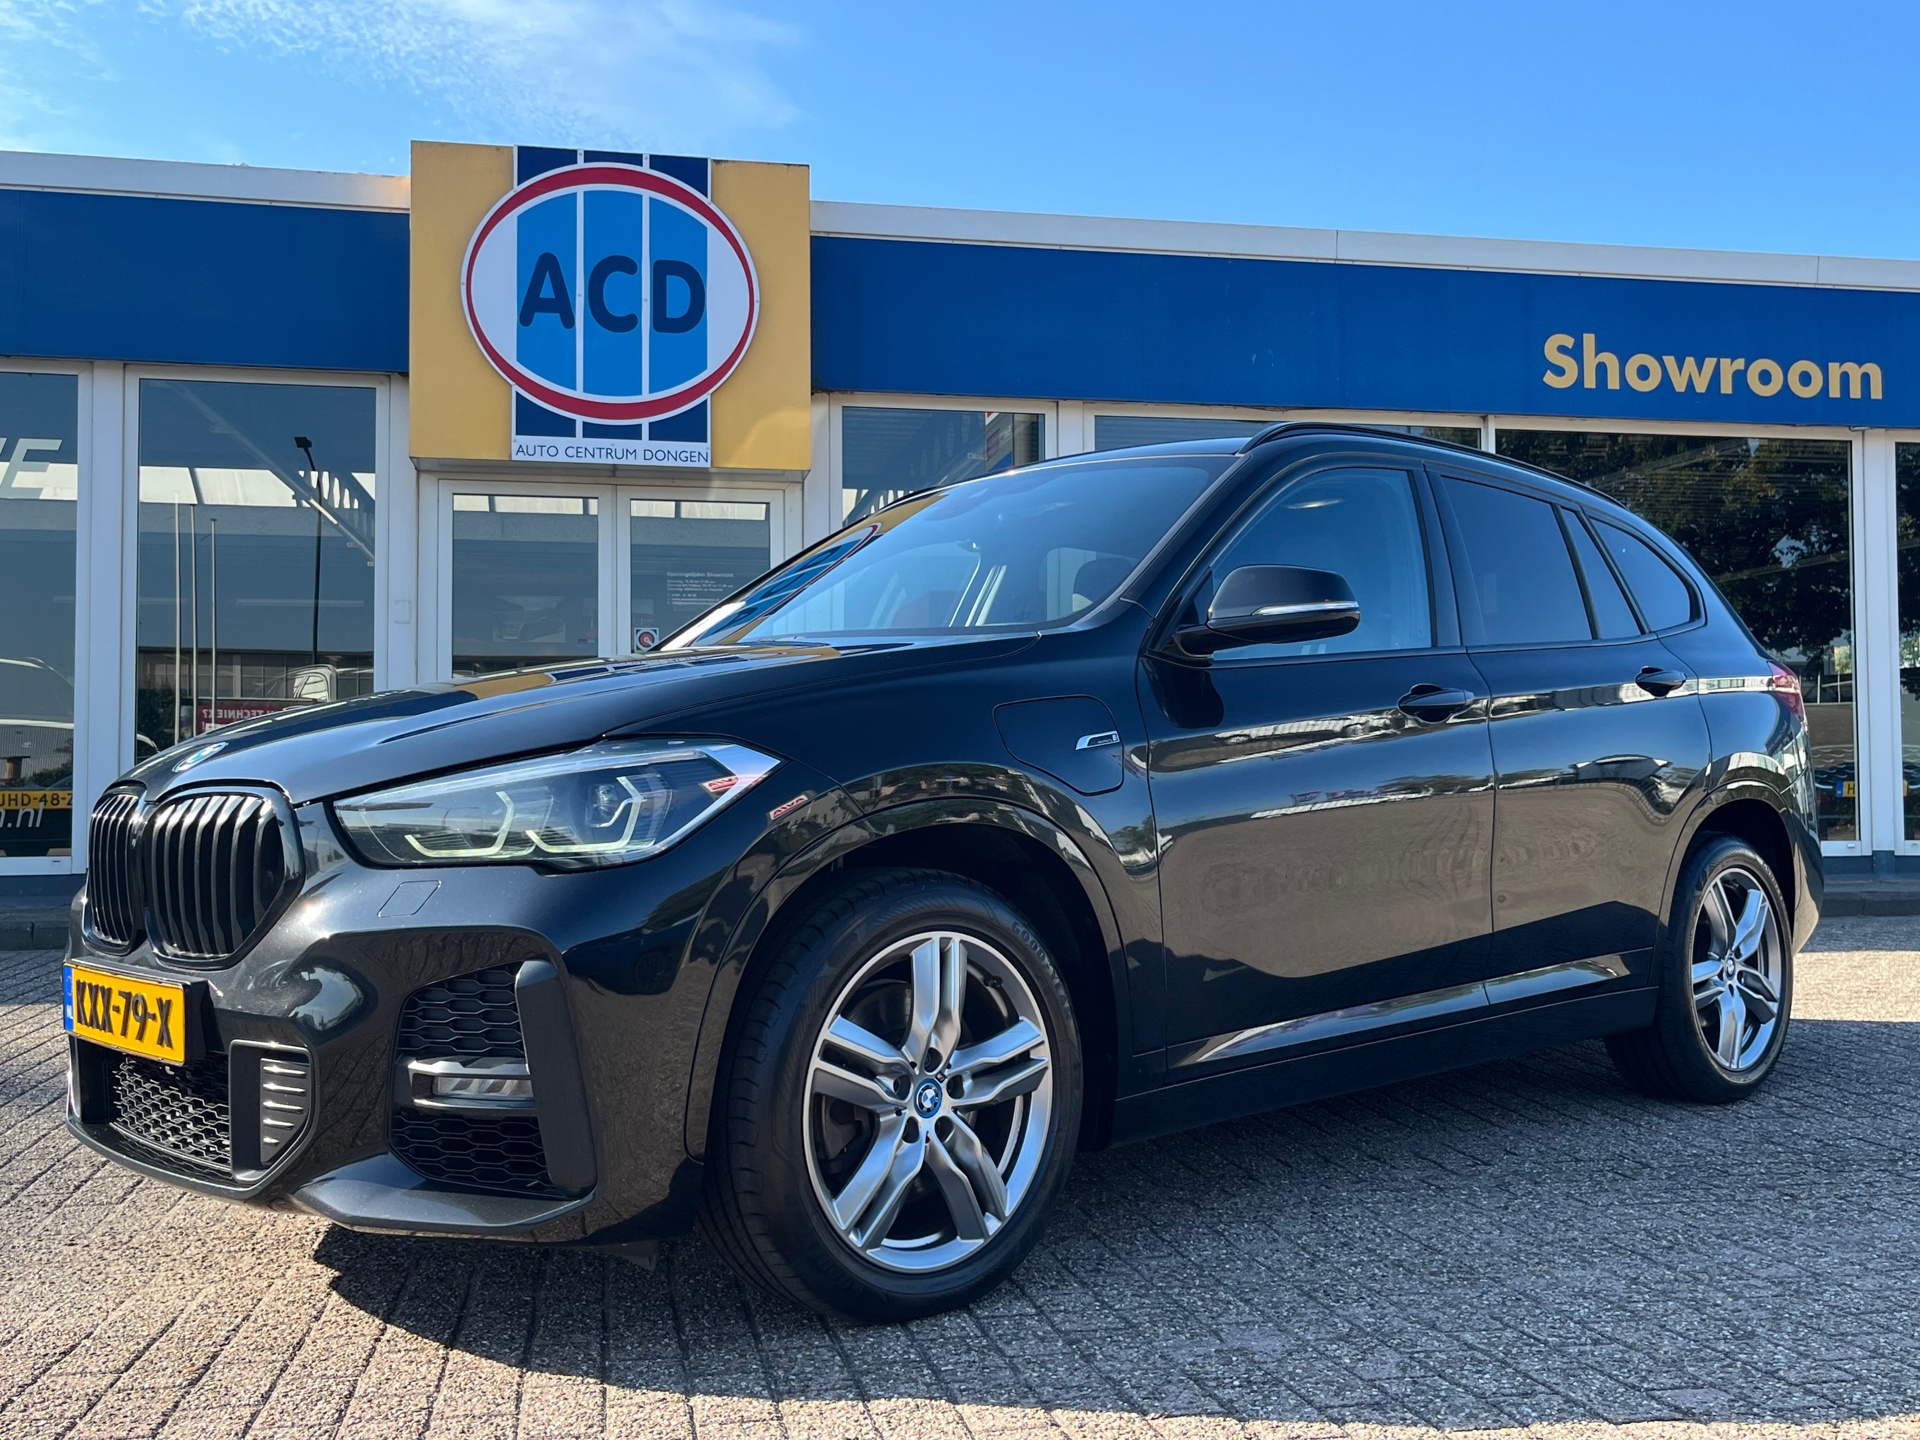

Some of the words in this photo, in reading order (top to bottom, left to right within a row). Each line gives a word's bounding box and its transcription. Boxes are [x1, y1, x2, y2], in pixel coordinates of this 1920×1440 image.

[519, 252, 706, 334] ACD
[1542, 333, 1883, 400] Showroom
[0, 436, 63, 499] E
[515, 444, 559, 458] AUTO
[564, 446, 637, 461] CENTRUM
[643, 449, 709, 464] DONGEN
[0, 801, 45, 828] .nl
[76, 979, 174, 1050] KXX-79-X
